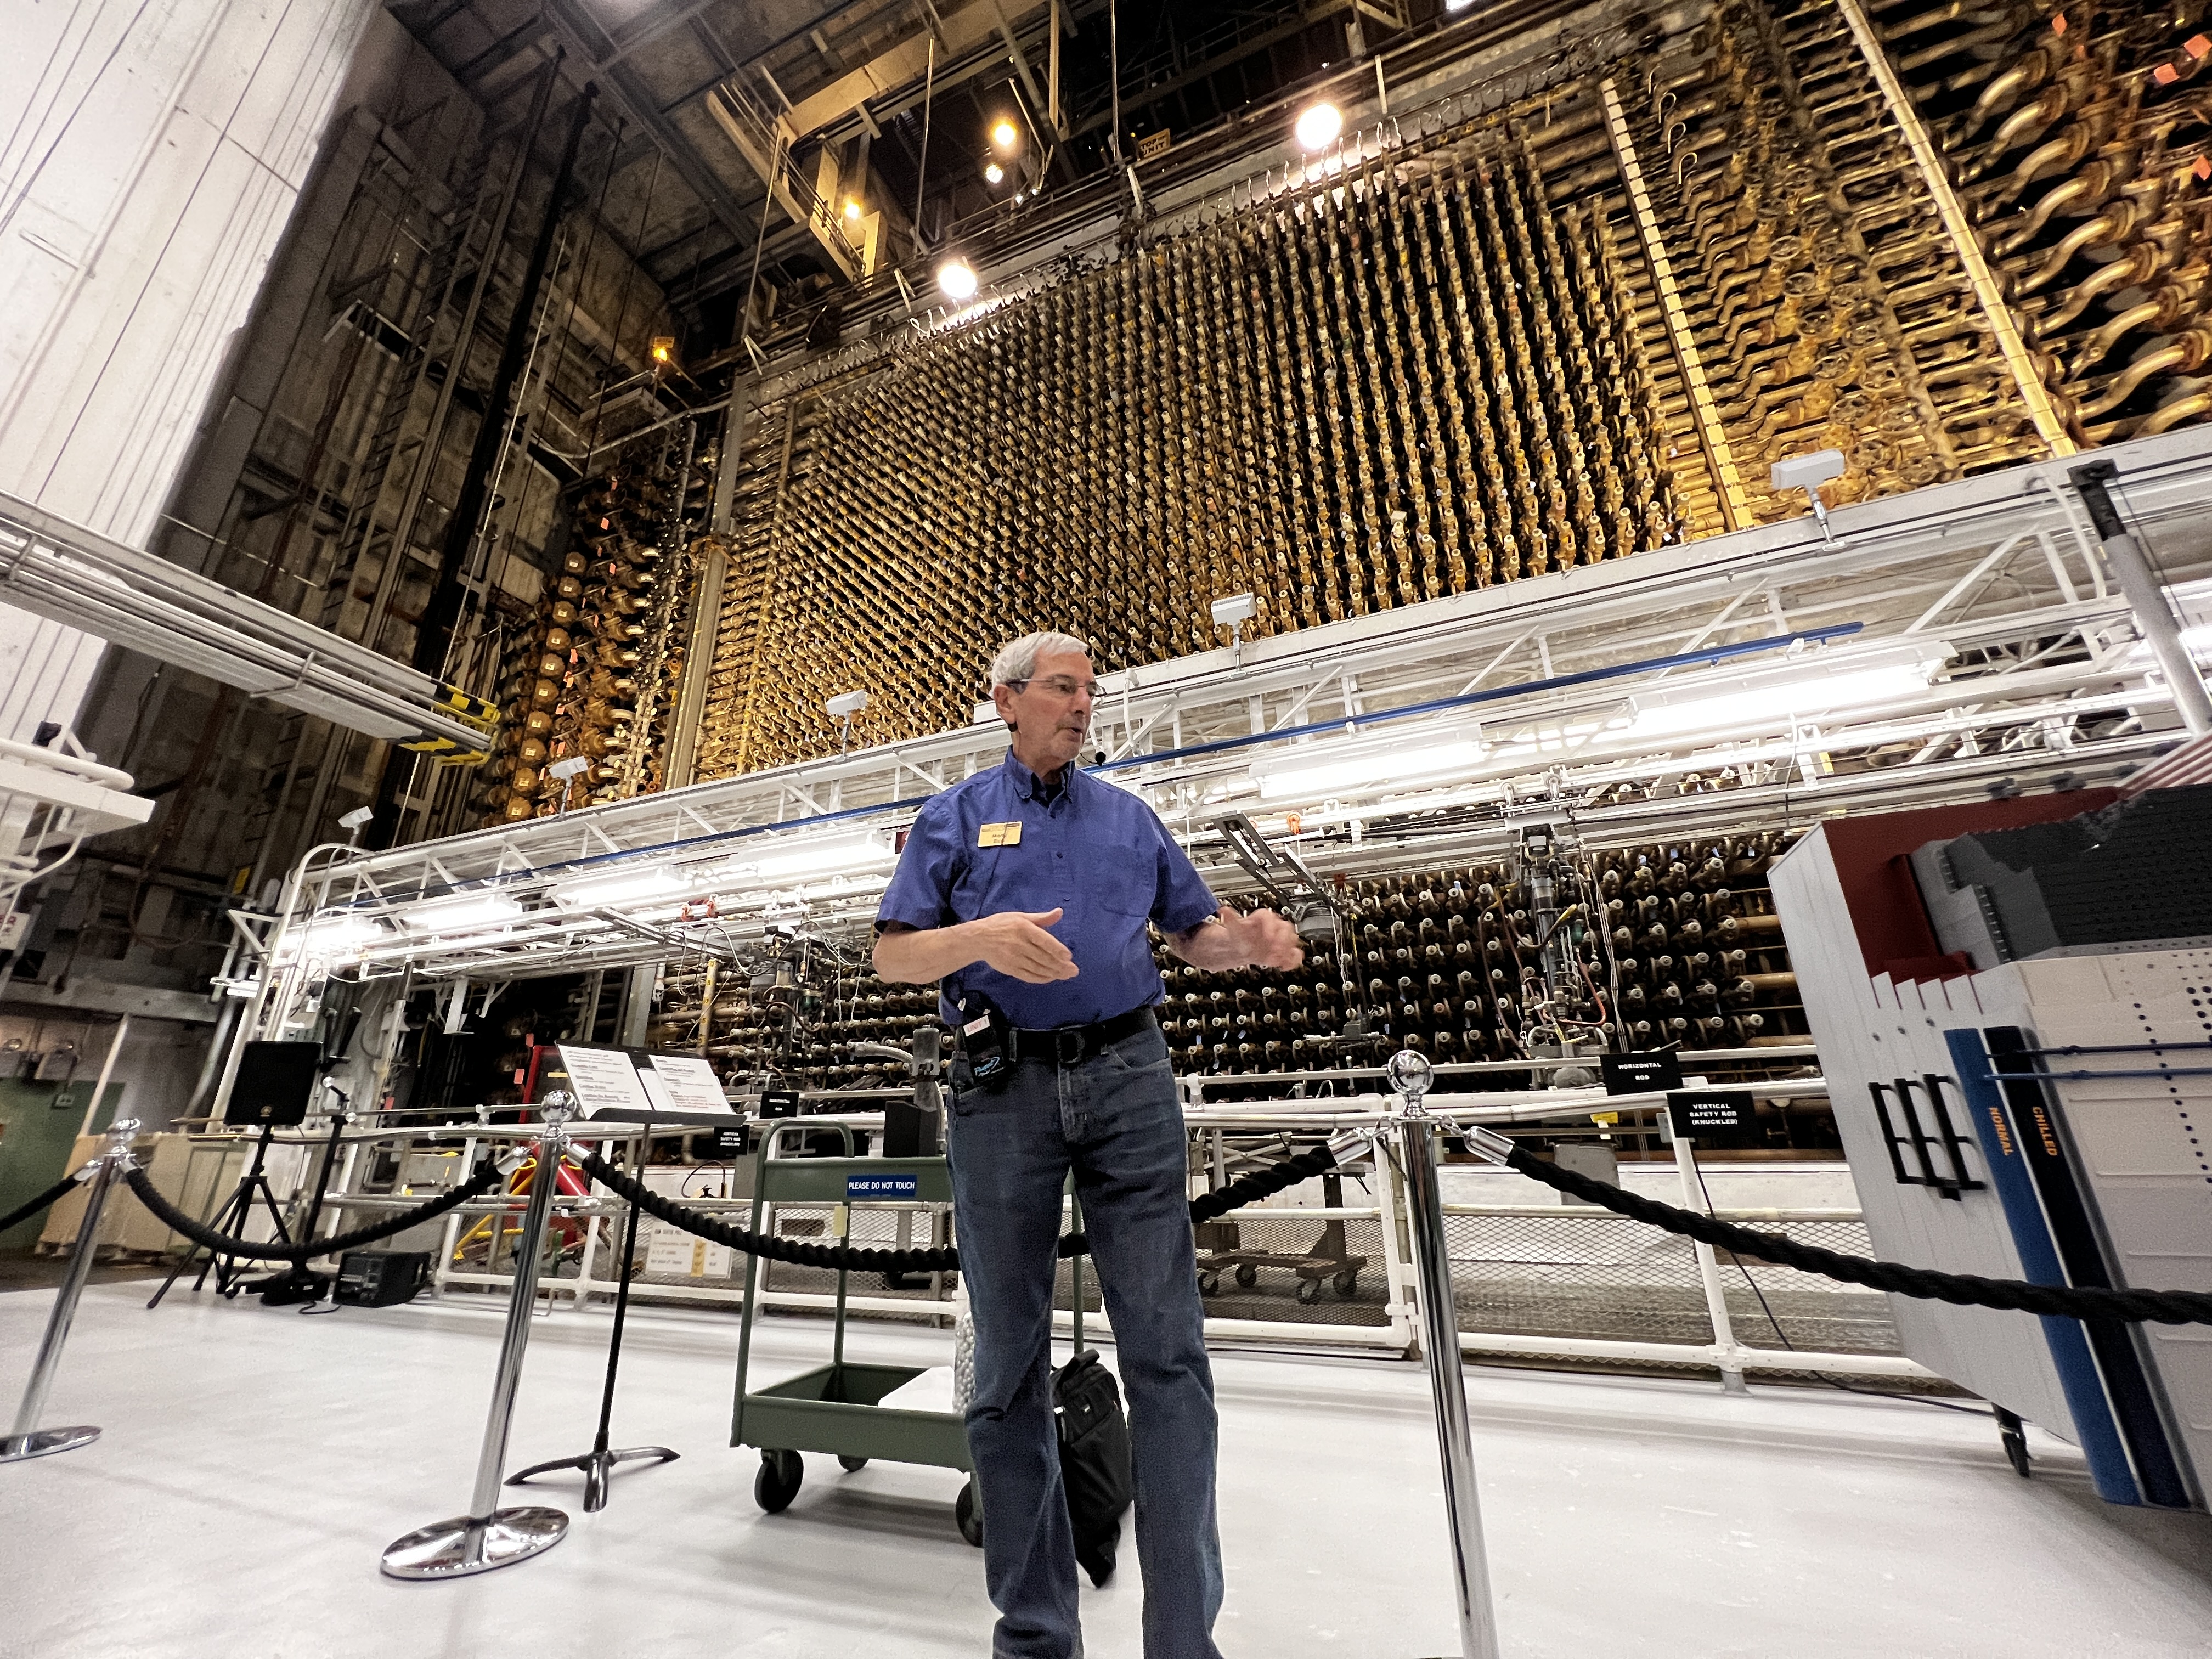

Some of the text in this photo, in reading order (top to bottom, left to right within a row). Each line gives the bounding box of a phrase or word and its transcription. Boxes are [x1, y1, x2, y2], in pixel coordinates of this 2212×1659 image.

[967, 1020, 981, 1032] UNIT
[1988, 1107, 2014, 1156] NORMAL
[2032, 1106, 2058, 1156] CHILLED
[848, 1182, 915, 1190] PLEASE DO NOT TOUCH
